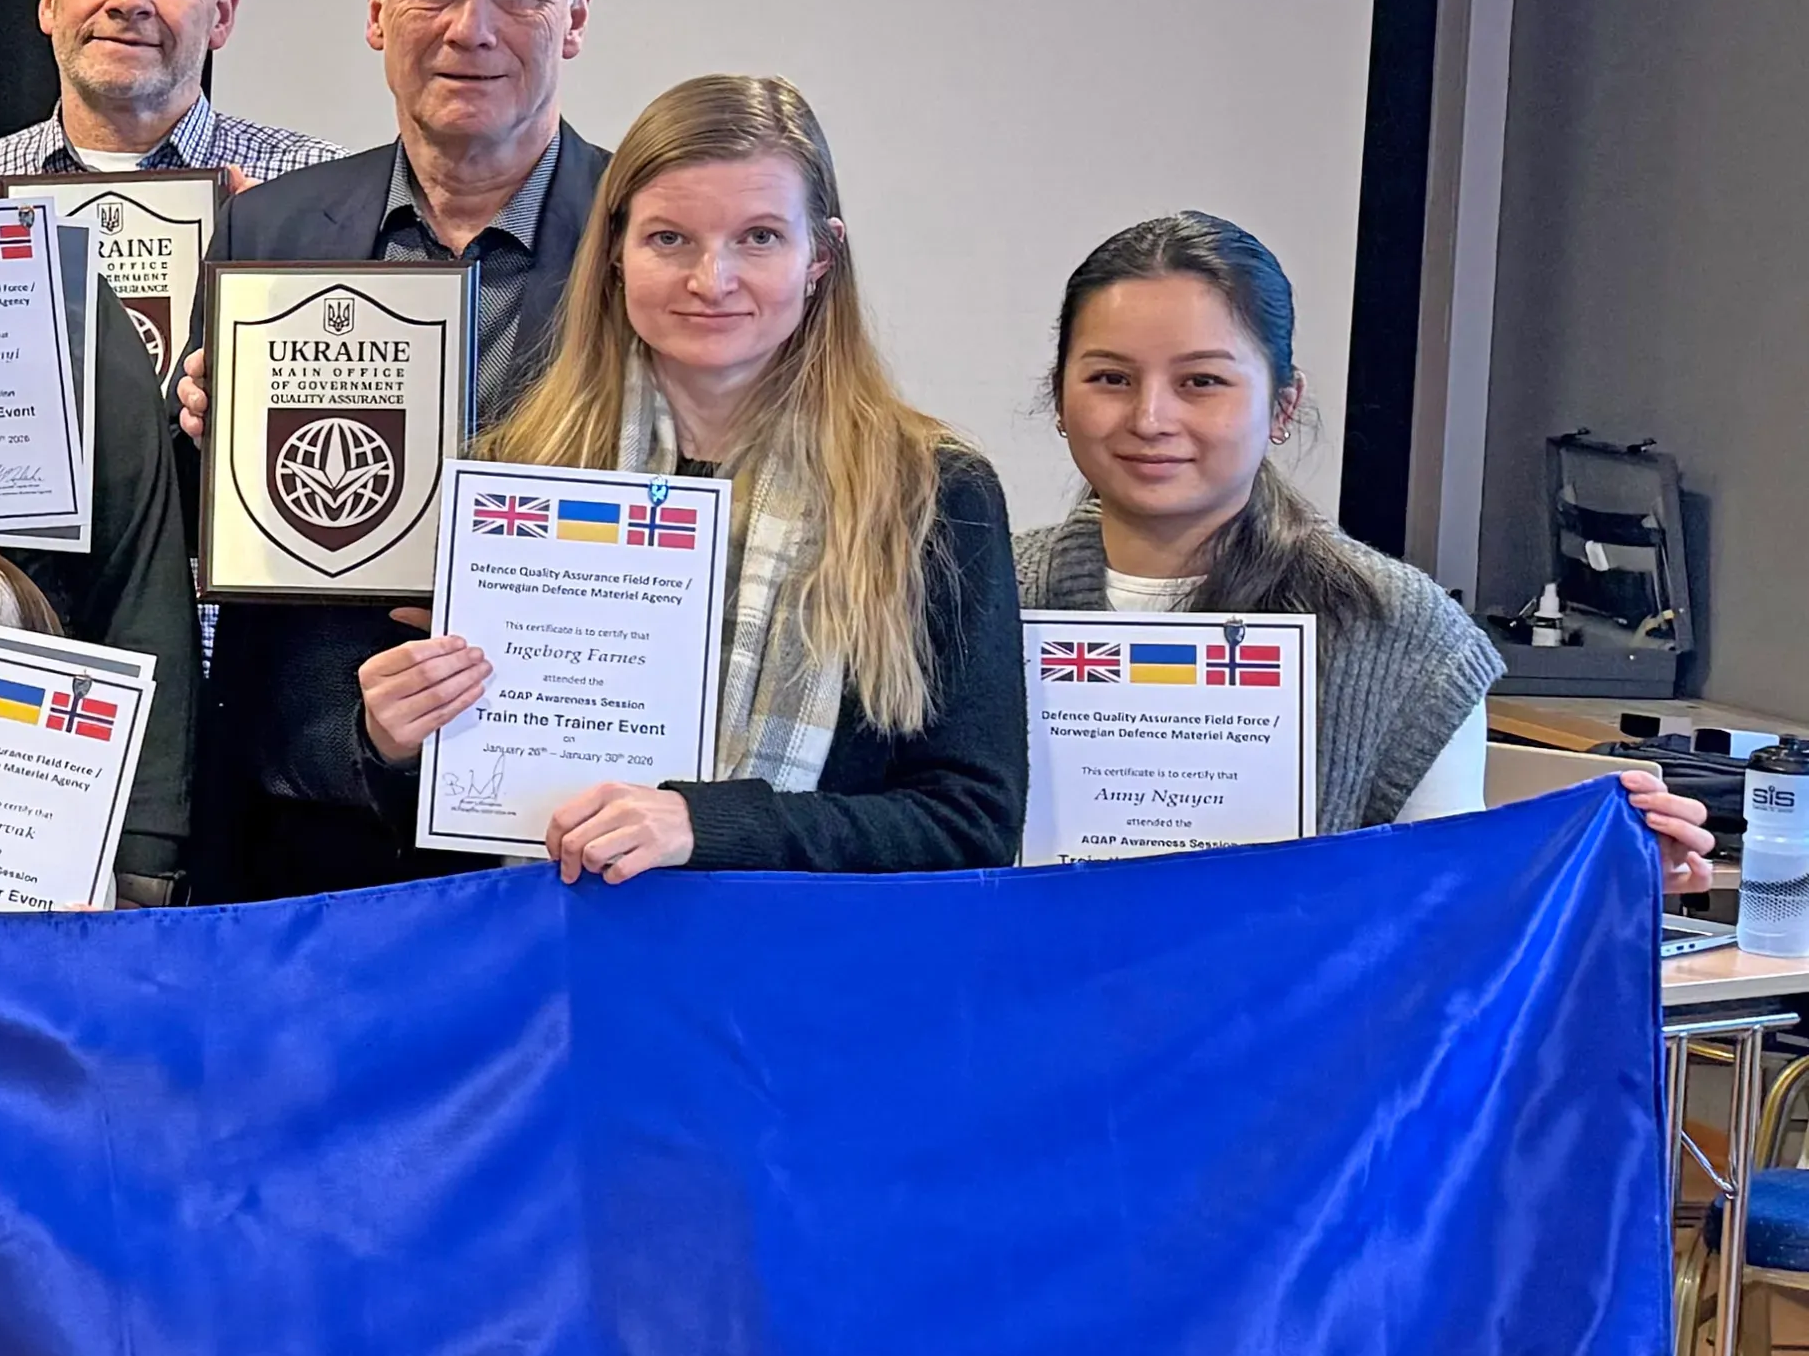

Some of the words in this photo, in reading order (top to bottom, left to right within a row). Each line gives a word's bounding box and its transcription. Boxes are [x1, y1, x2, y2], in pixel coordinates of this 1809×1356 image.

[98, 238, 172, 258] AINE
[107, 261, 168, 271] OFFICE
[106, 273, 168, 283] ERNMENT
[113, 284, 169, 293] SURANCE
[268, 341, 411, 363] UKRAINE
[272, 367, 321, 377] MAIN
[333, 367, 405, 377] OFFICE
[270, 381, 290, 391] OF
[297, 381, 404, 391] GOVERNMENT
[270, 394, 326, 404] QUALITY
[328, 394, 405, 404] ASSURANCE
[470, 562, 516, 575] Defence
[518, 566, 560, 580] Quality
[561, 569, 620, 583] Assurance
[622, 573, 650, 585] Field
[652, 576, 683, 588] Force
[477, 578, 539, 593] Norwegian
[541, 583, 587, 596] Defence
[590, 587, 639, 600] Materiel
[640, 591, 682, 606] Agency
[505, 620, 523, 630] This
[525, 623, 573, 634] certificate
[574, 626, 582, 635] is
[584, 627, 596, 636] to
[597, 629, 628, 640] certify
[630, 631, 649, 640] that
[542, 674, 586, 685] attended
[587, 676, 604, 686] the
[498, 689, 533, 700] AQAP
[535, 692, 597, 706] Awareness
[600, 697, 645, 710] Session
[475, 707, 517, 723] Train
[523, 712, 549, 726] the
[553, 713, 614, 731] Trainer
[618, 718, 665, 736] Event
[1041, 709, 1090, 721] Defence
[1092, 711, 1137, 724] Quality
[1138, 713, 1201, 724] Assurance
[1204, 714, 1233, 725] Field
[1236, 715, 1270, 726] Force
[562, 735, 575, 743] on
[1049, 726, 1115, 739] Norwegian
[1118, 727, 1167, 739] Defence
[1170, 729, 1223, 740] Materiel
[1225, 730, 1270, 743] Agency
[1080, 765, 1101, 776] This
[1103, 767, 1155, 777] certificate
[1157, 768, 1165, 778] is
[1167, 769, 1179, 778] to
[1180, 769, 1215, 780] certify
[1216, 770, 1237, 780] that
[1080, 835, 1116, 845] AQAP
[1120, 836, 1186, 848] Awareness
[7, 886, 54, 911] Event
